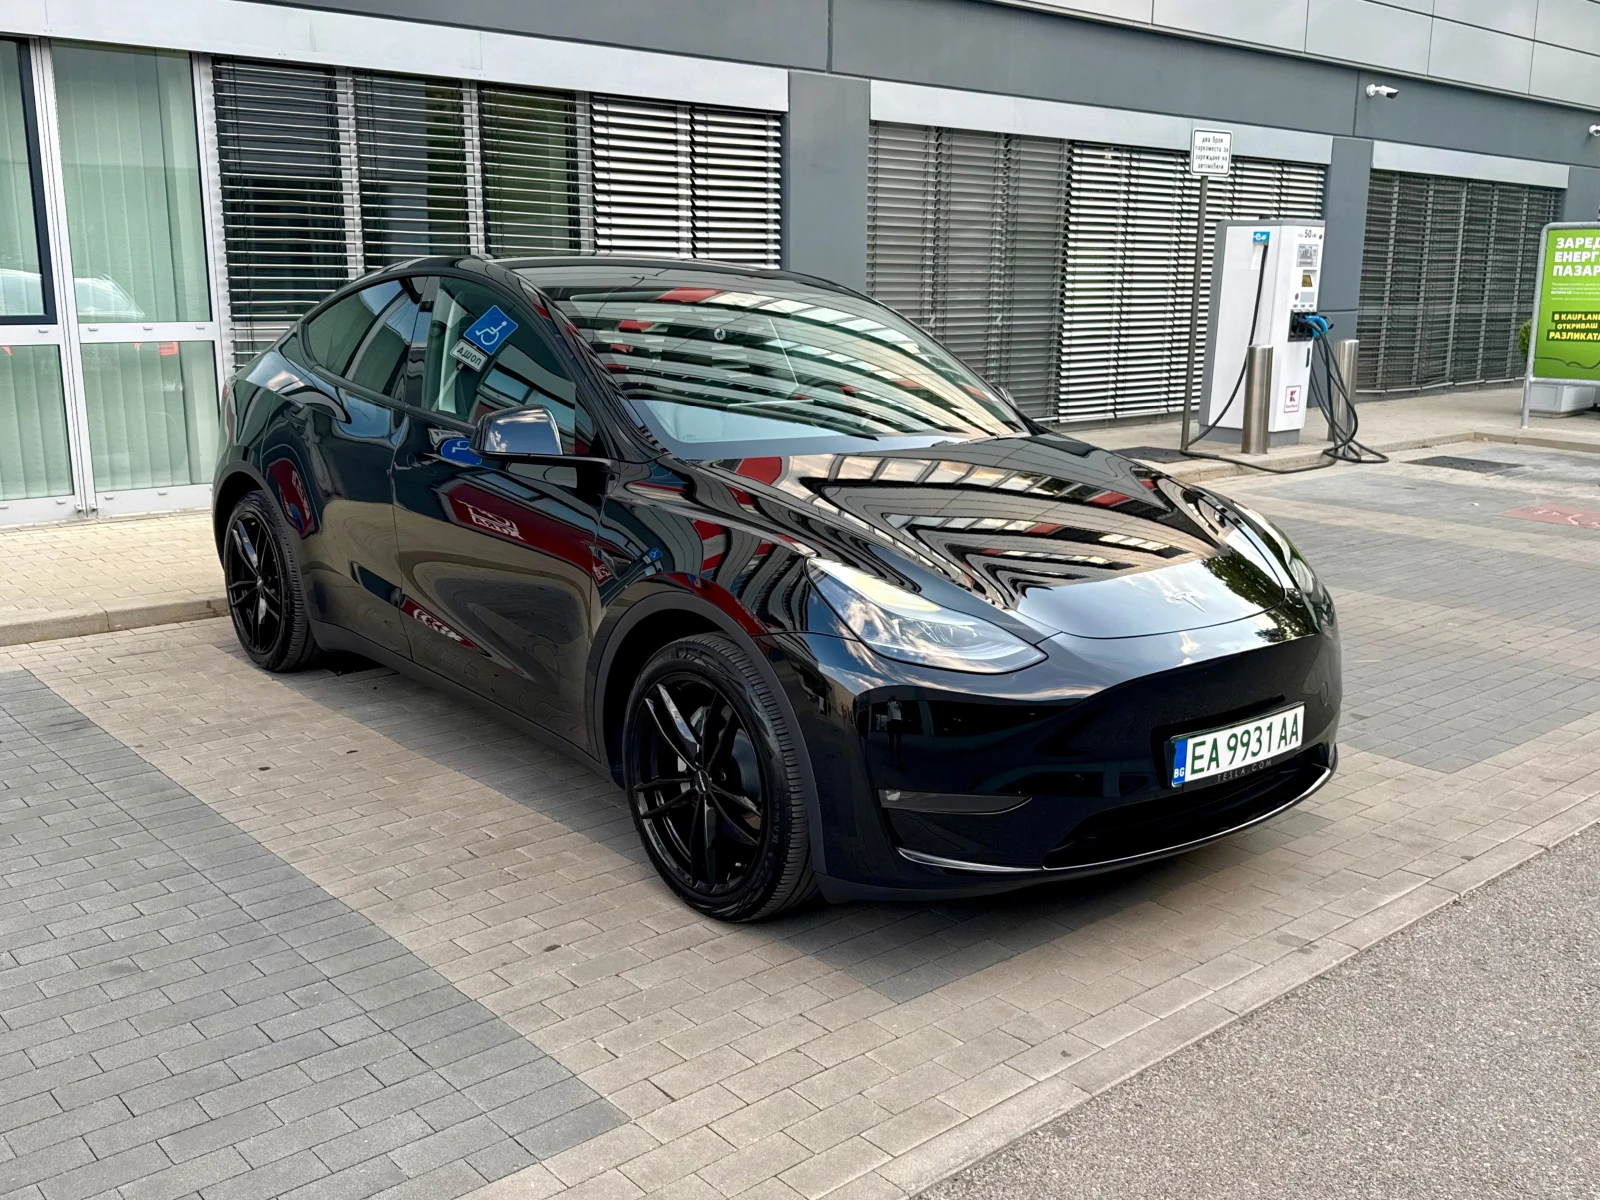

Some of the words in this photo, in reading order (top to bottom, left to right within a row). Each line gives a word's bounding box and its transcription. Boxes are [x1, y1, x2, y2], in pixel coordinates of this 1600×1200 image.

[1305, 229, 1312, 238] 50
[1554, 251, 1600, 262] ЕНЕРГ
[1191, 738, 1219, 775] EA
[1227, 722, 1273, 765] 9931
[1277, 713, 1299, 750] AA
[1174, 767, 1185, 778] BG
[1217, 759, 1272, 782] TESLA.COM
